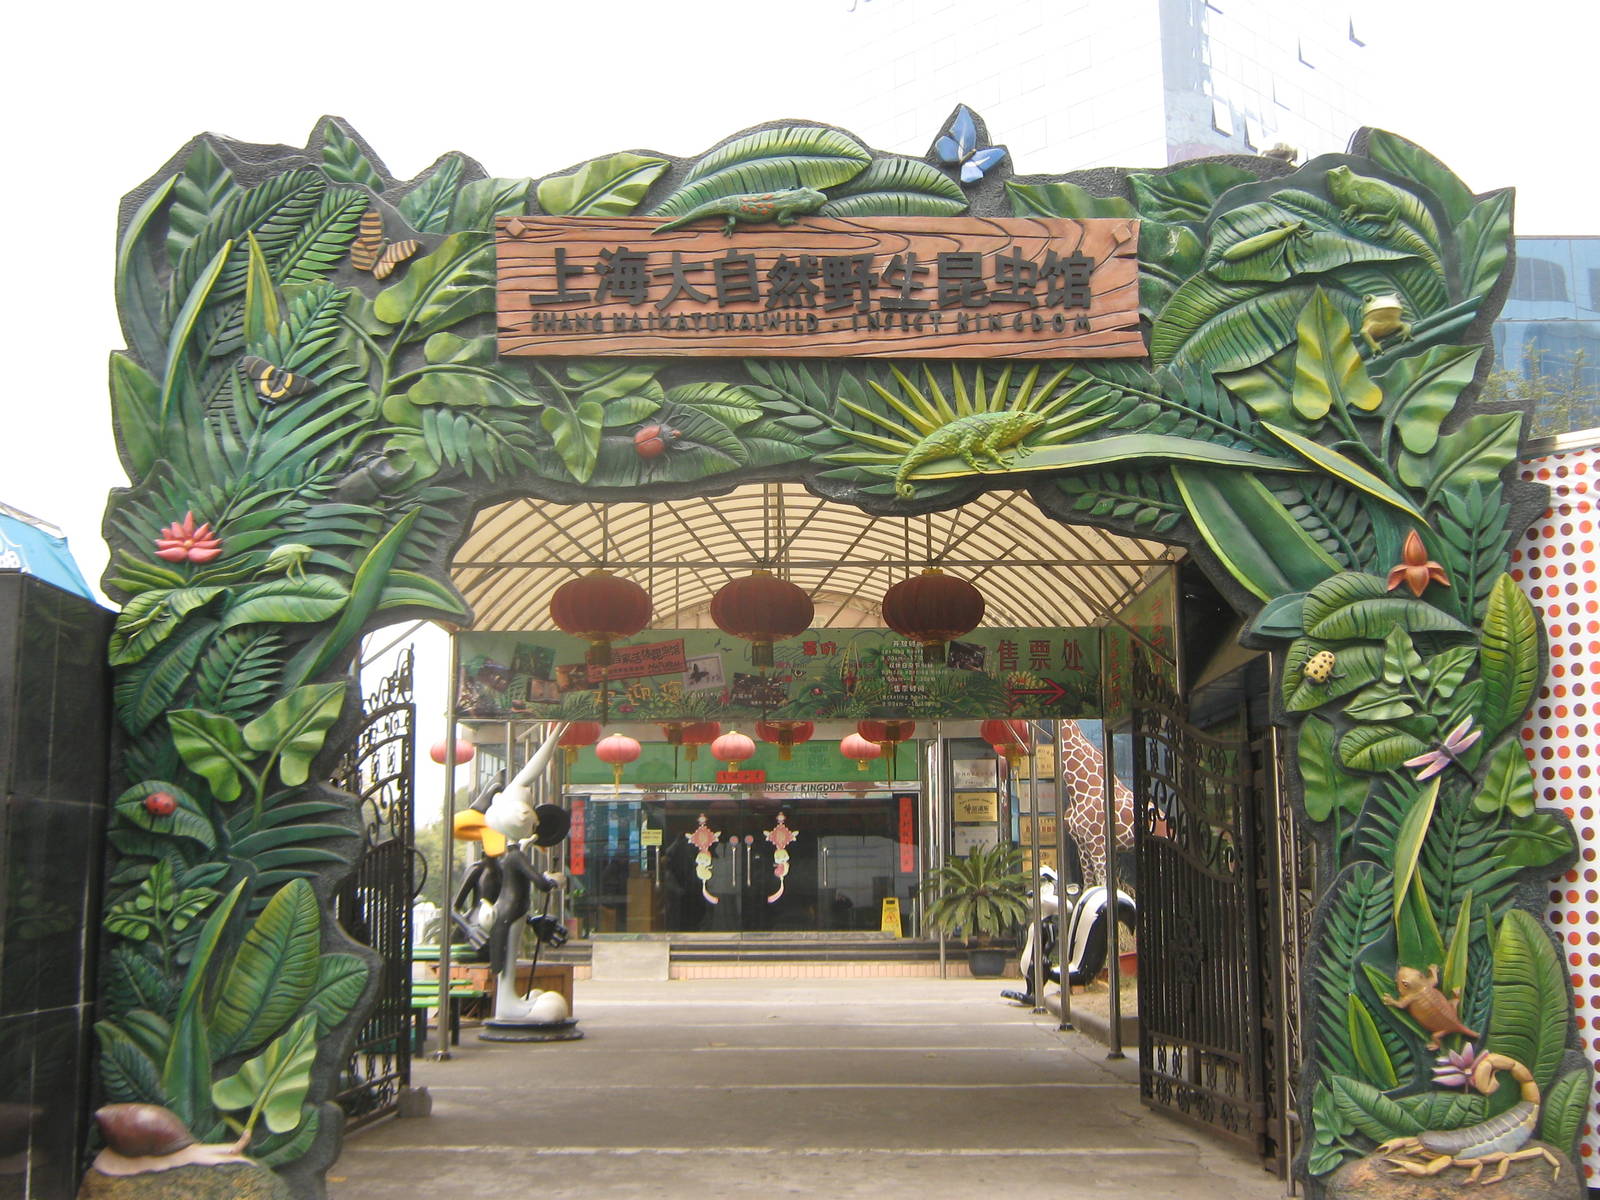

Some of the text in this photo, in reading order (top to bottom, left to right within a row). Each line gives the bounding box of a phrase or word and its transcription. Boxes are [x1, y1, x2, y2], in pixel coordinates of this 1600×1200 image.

[529, 246, 1095, 312] 上海大自然野生昆虫馆
[852, 312, 942, 332] INSECT
[957, 312, 1091, 332] KINGDOM
[997, 639, 1084, 671] 售票处
